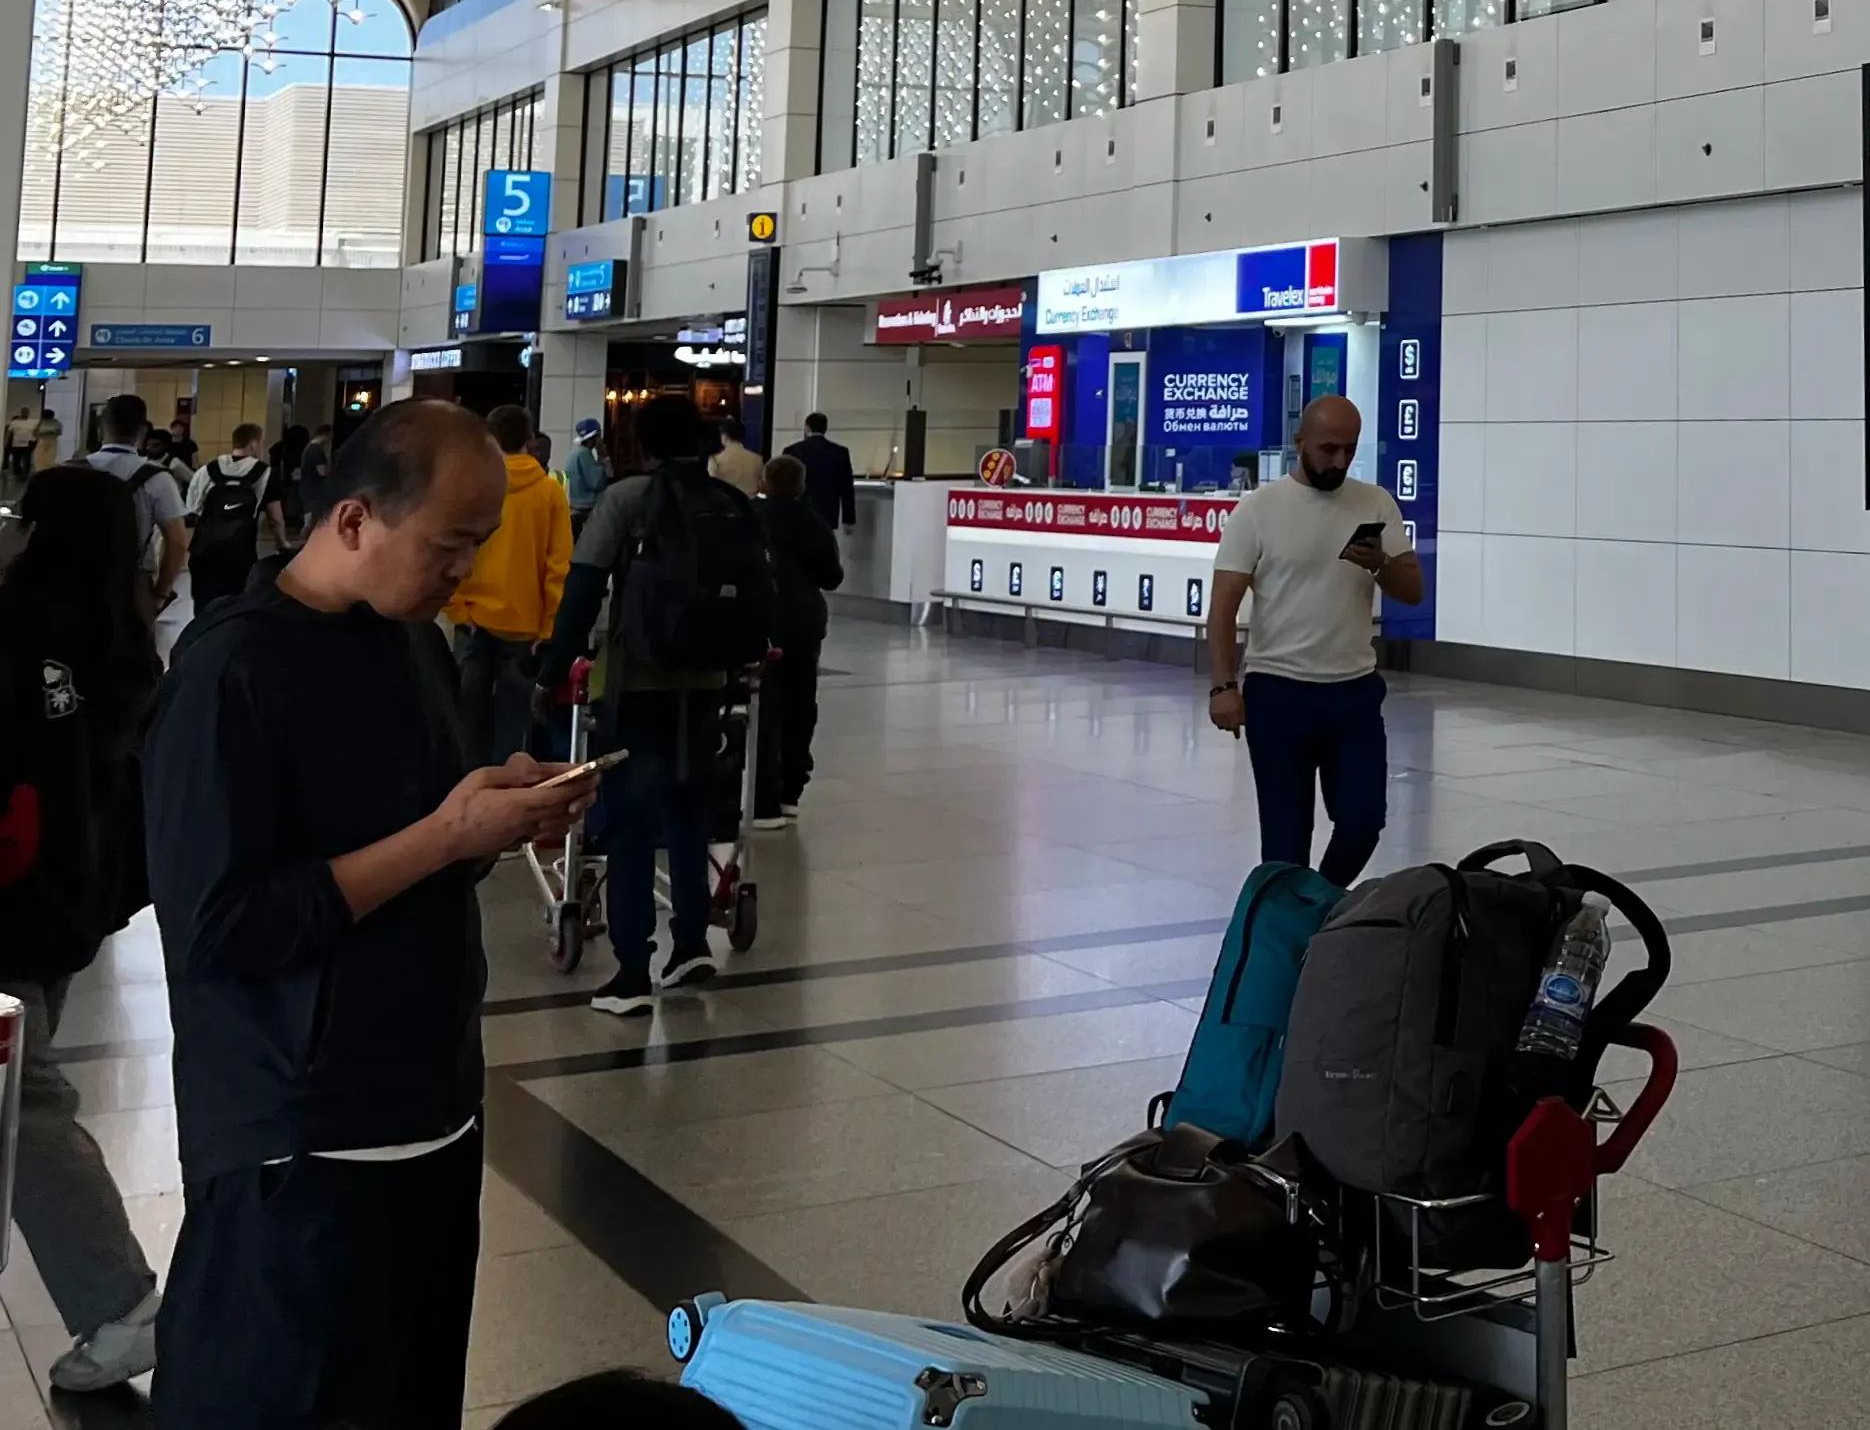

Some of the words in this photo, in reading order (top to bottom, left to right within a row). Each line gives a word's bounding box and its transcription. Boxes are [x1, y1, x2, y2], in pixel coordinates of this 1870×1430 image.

[503, 173, 531, 217] 5
[1262, 284, 1304, 308] Travelex
[191, 327, 204, 345] 6
[1031, 373, 1053, 392] ATM
[1163, 373, 1249, 387] CURRENCY
[1163, 386, 1249, 401] EXCHANGE
[1209, 404, 1249, 421] صرافة
[1163, 420, 1202, 432] Обмен
[1202, 421, 1249, 432] валюты
